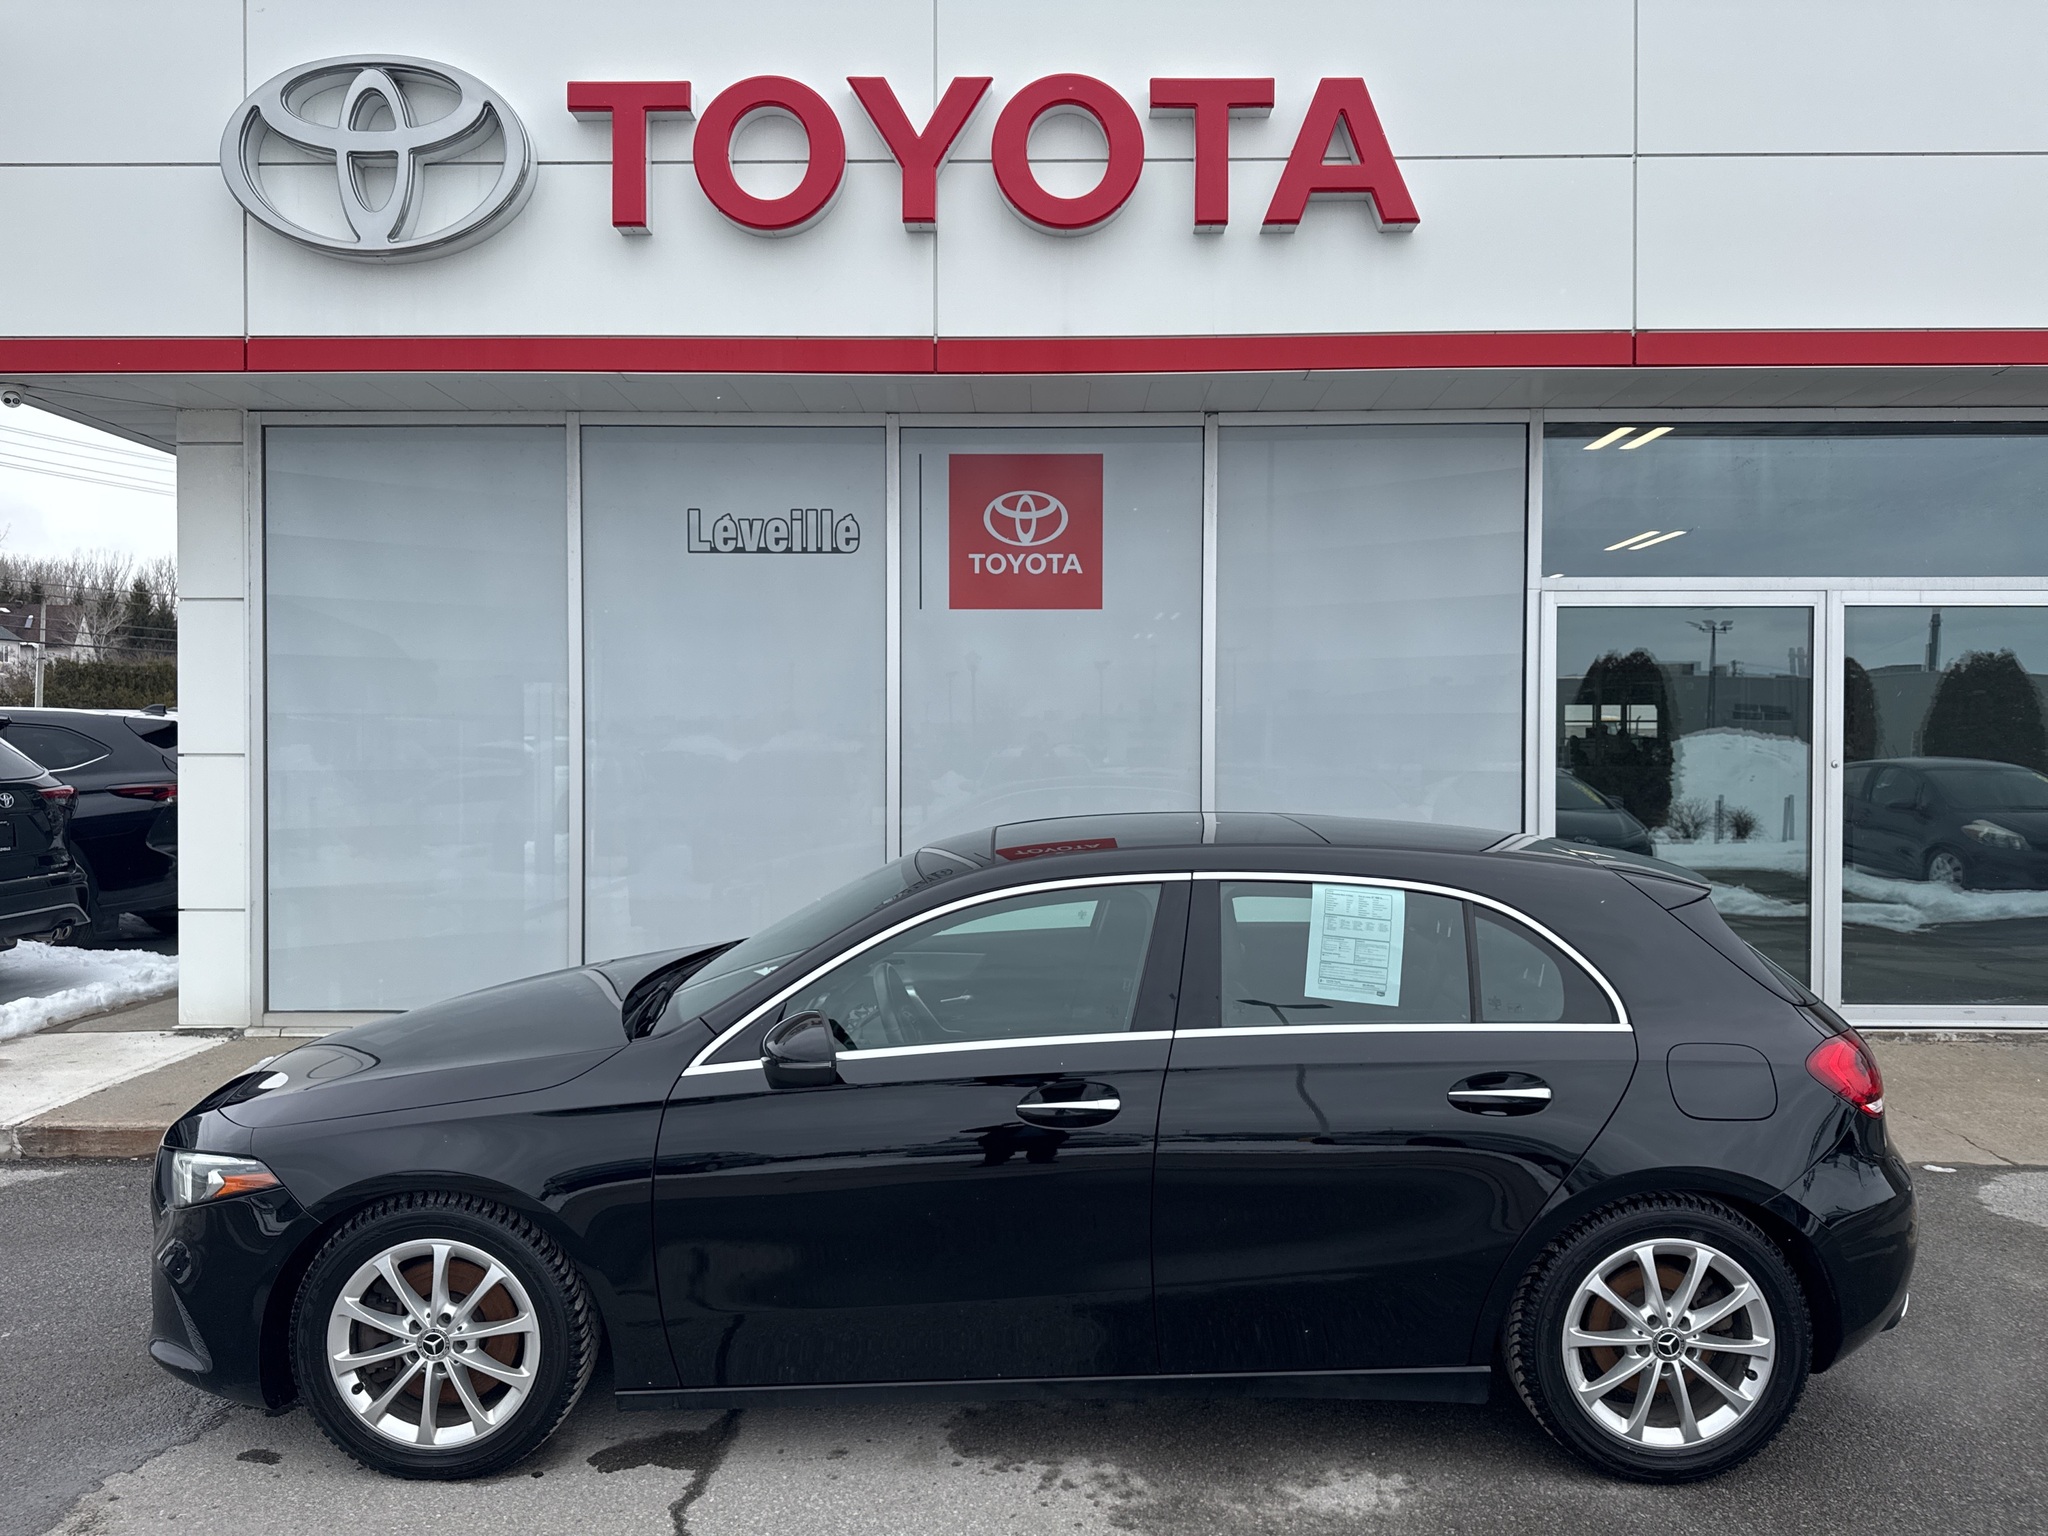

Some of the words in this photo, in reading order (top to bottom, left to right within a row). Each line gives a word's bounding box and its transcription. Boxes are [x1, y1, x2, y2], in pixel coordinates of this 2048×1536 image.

[566, 74, 1421, 237] TOYOTA
[687, 508, 861, 554] Léveillé
[969, 553, 1084, 575] TOYOTA
